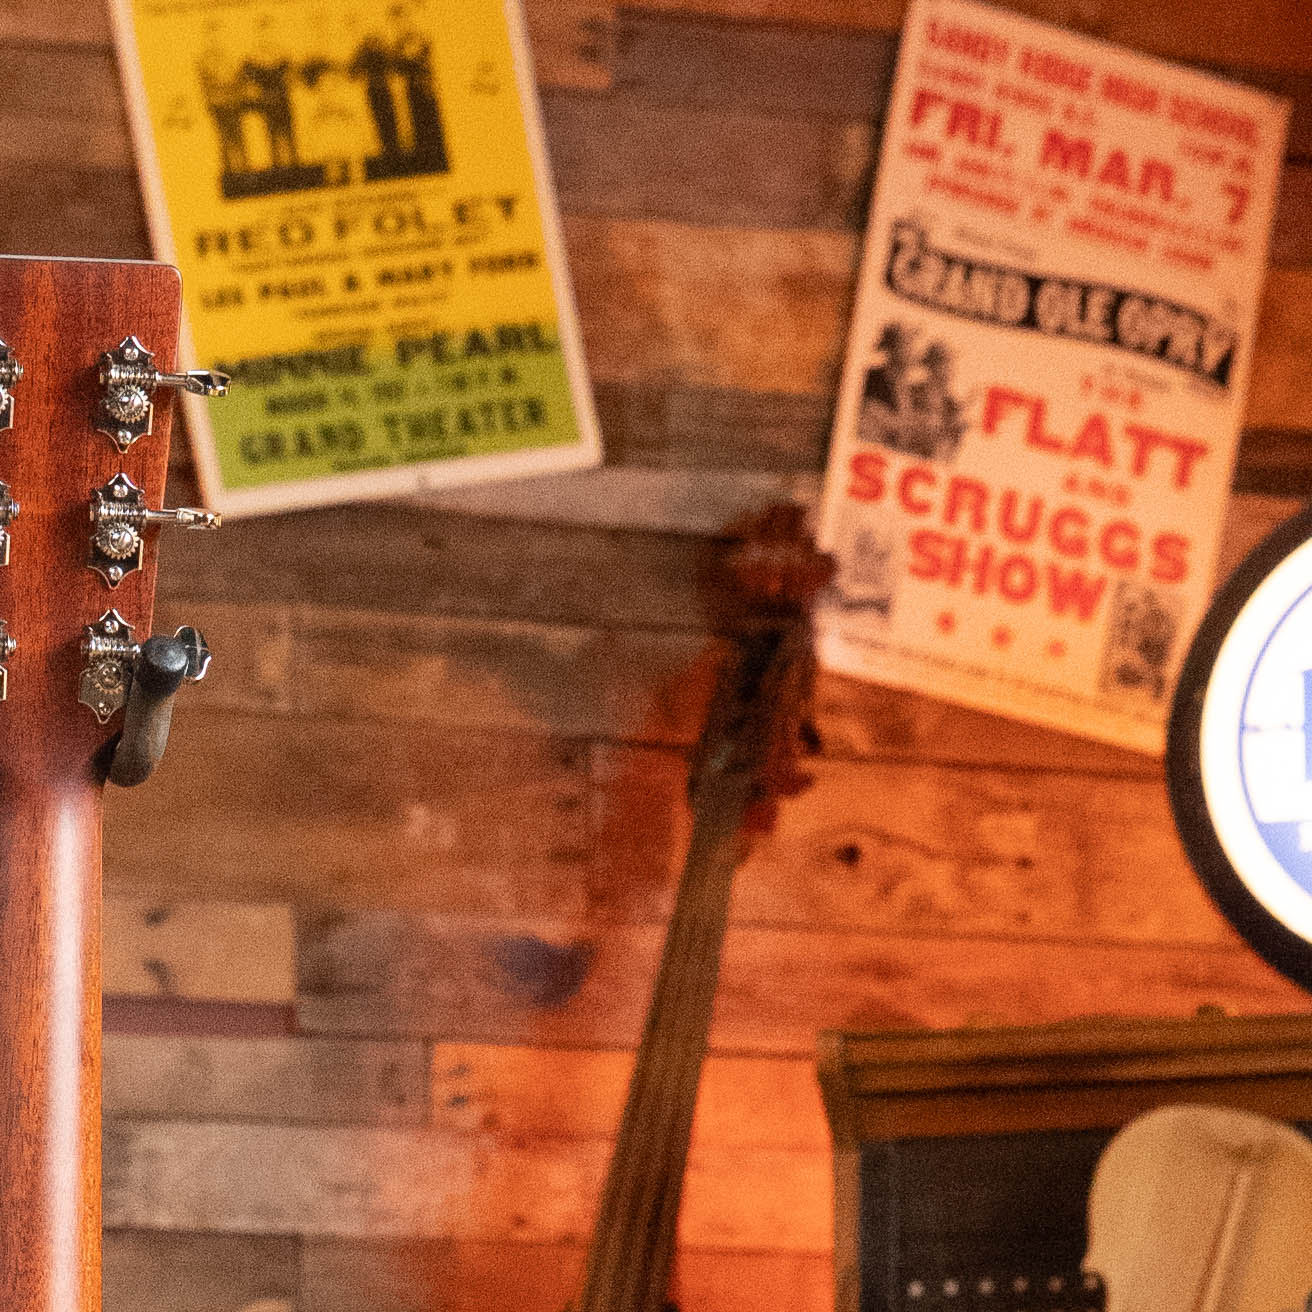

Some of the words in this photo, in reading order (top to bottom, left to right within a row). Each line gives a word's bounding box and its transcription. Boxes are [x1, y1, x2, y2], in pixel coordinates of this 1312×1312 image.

[1222, 183, 1249, 224] 7
[890, 248, 1031, 326] GRAND
[1035, 278, 1112, 340] OLE
[1116, 292, 1239, 385] OPRY
[983, 388, 1208, 489] FLATT
[847, 450, 1190, 584] SCRUGGS
[908, 529, 1106, 624] SHOW
